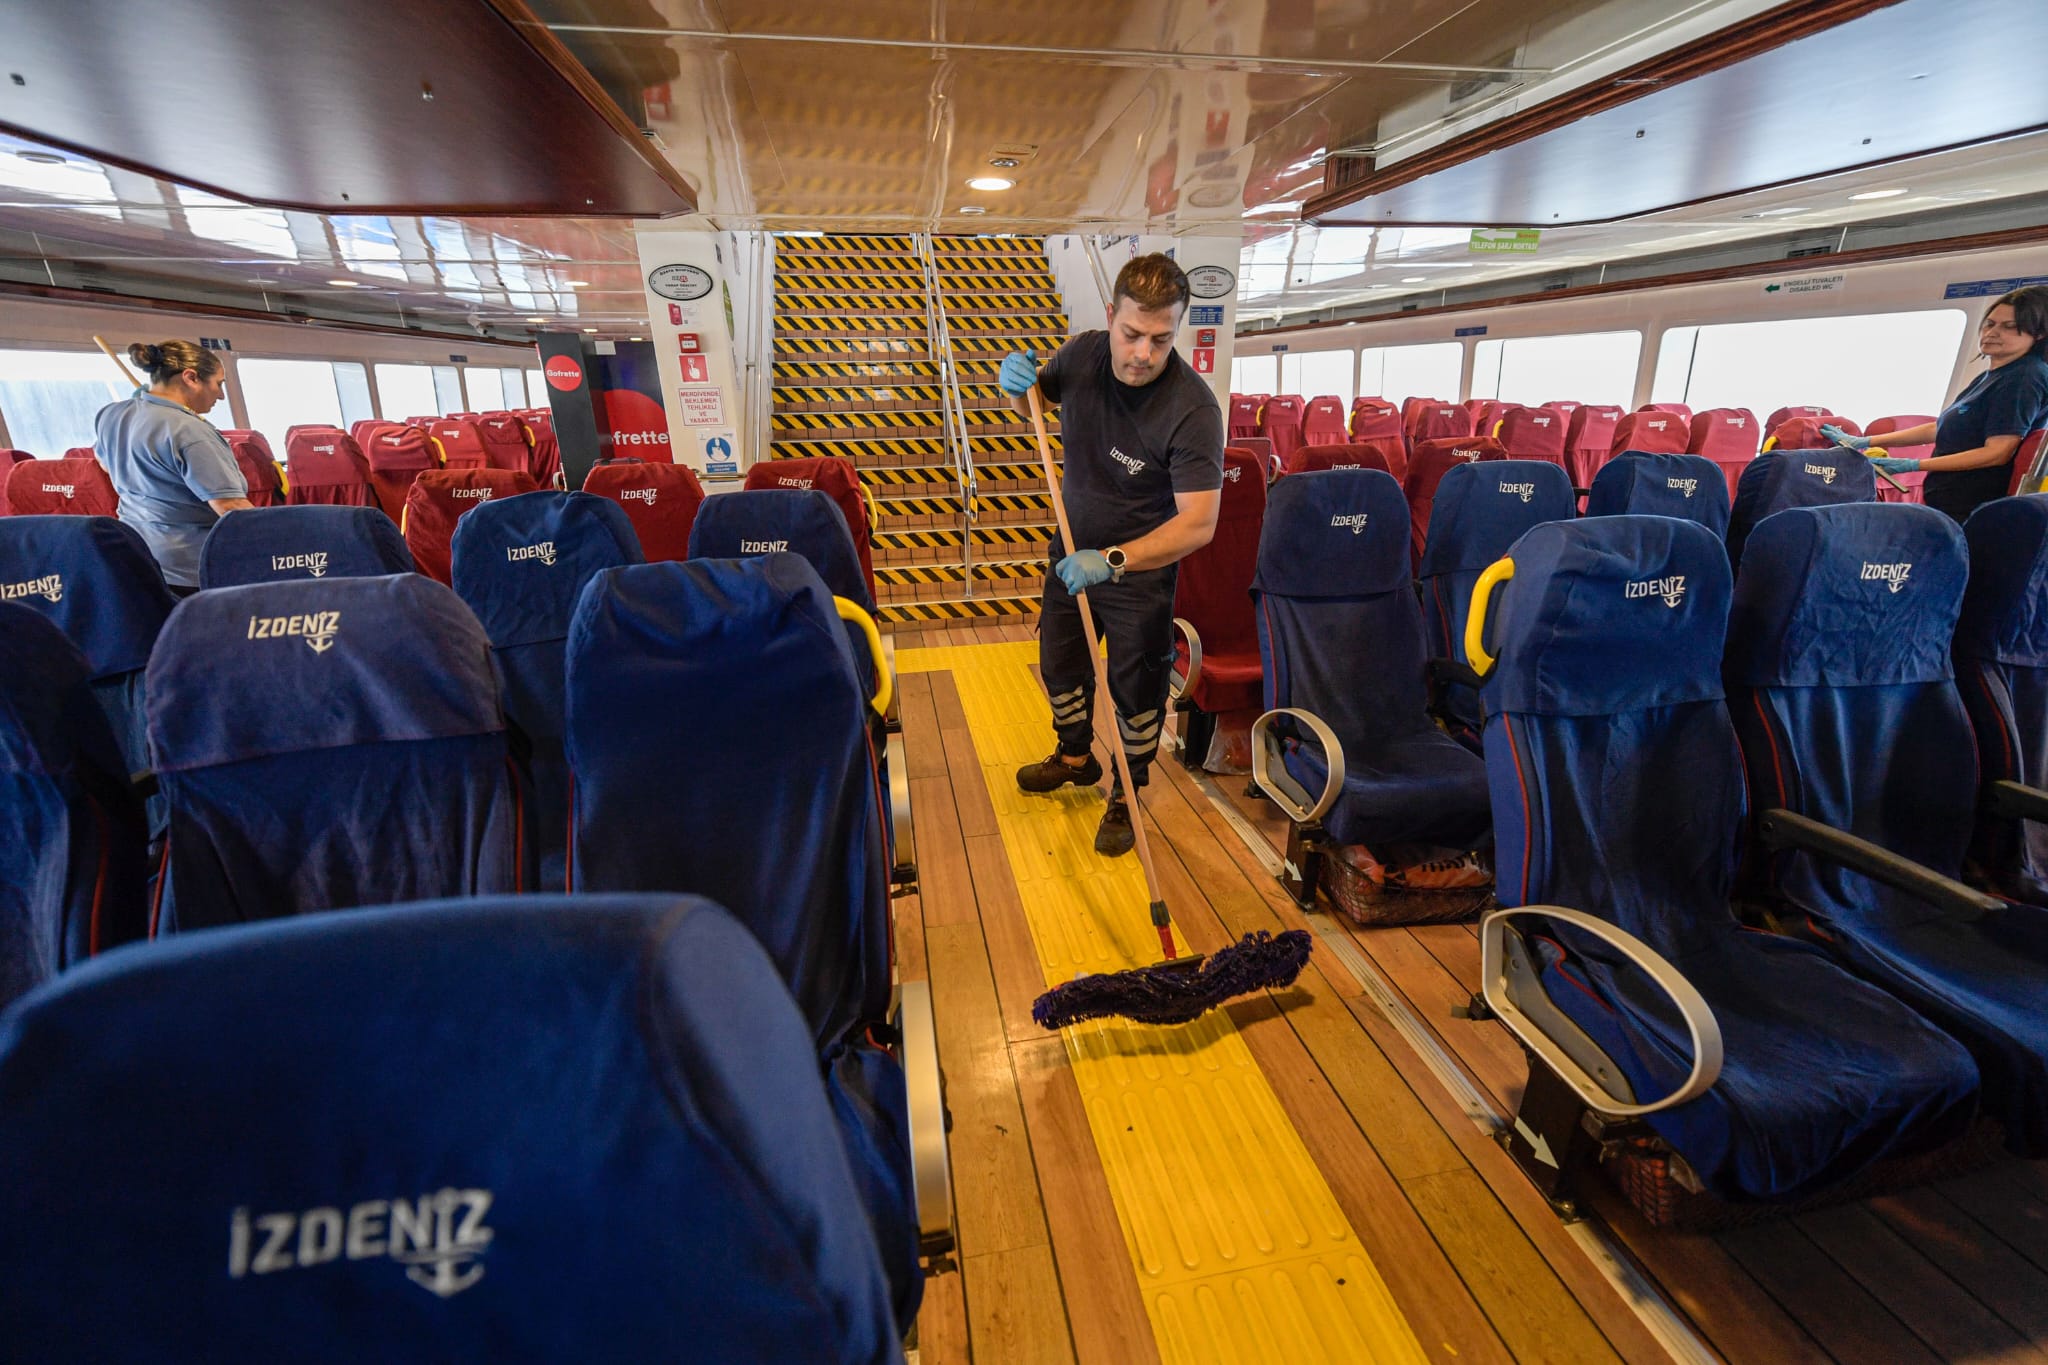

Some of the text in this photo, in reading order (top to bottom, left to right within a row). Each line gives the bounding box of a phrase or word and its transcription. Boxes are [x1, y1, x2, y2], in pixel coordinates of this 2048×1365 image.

[547, 369, 580, 378] Gofrette
[612, 430, 669, 446] frette
[741, 539, 788, 553] İZDENİZ
[272, 552, 328, 573] İZDENİZ
[1860, 561, 1911, 586] İZDENİZ
[1625, 576, 1686, 603] İZDENİZ
[247, 611, 340, 647] İZDENİZ
[229, 1187, 494, 1297] İZDENİZ
